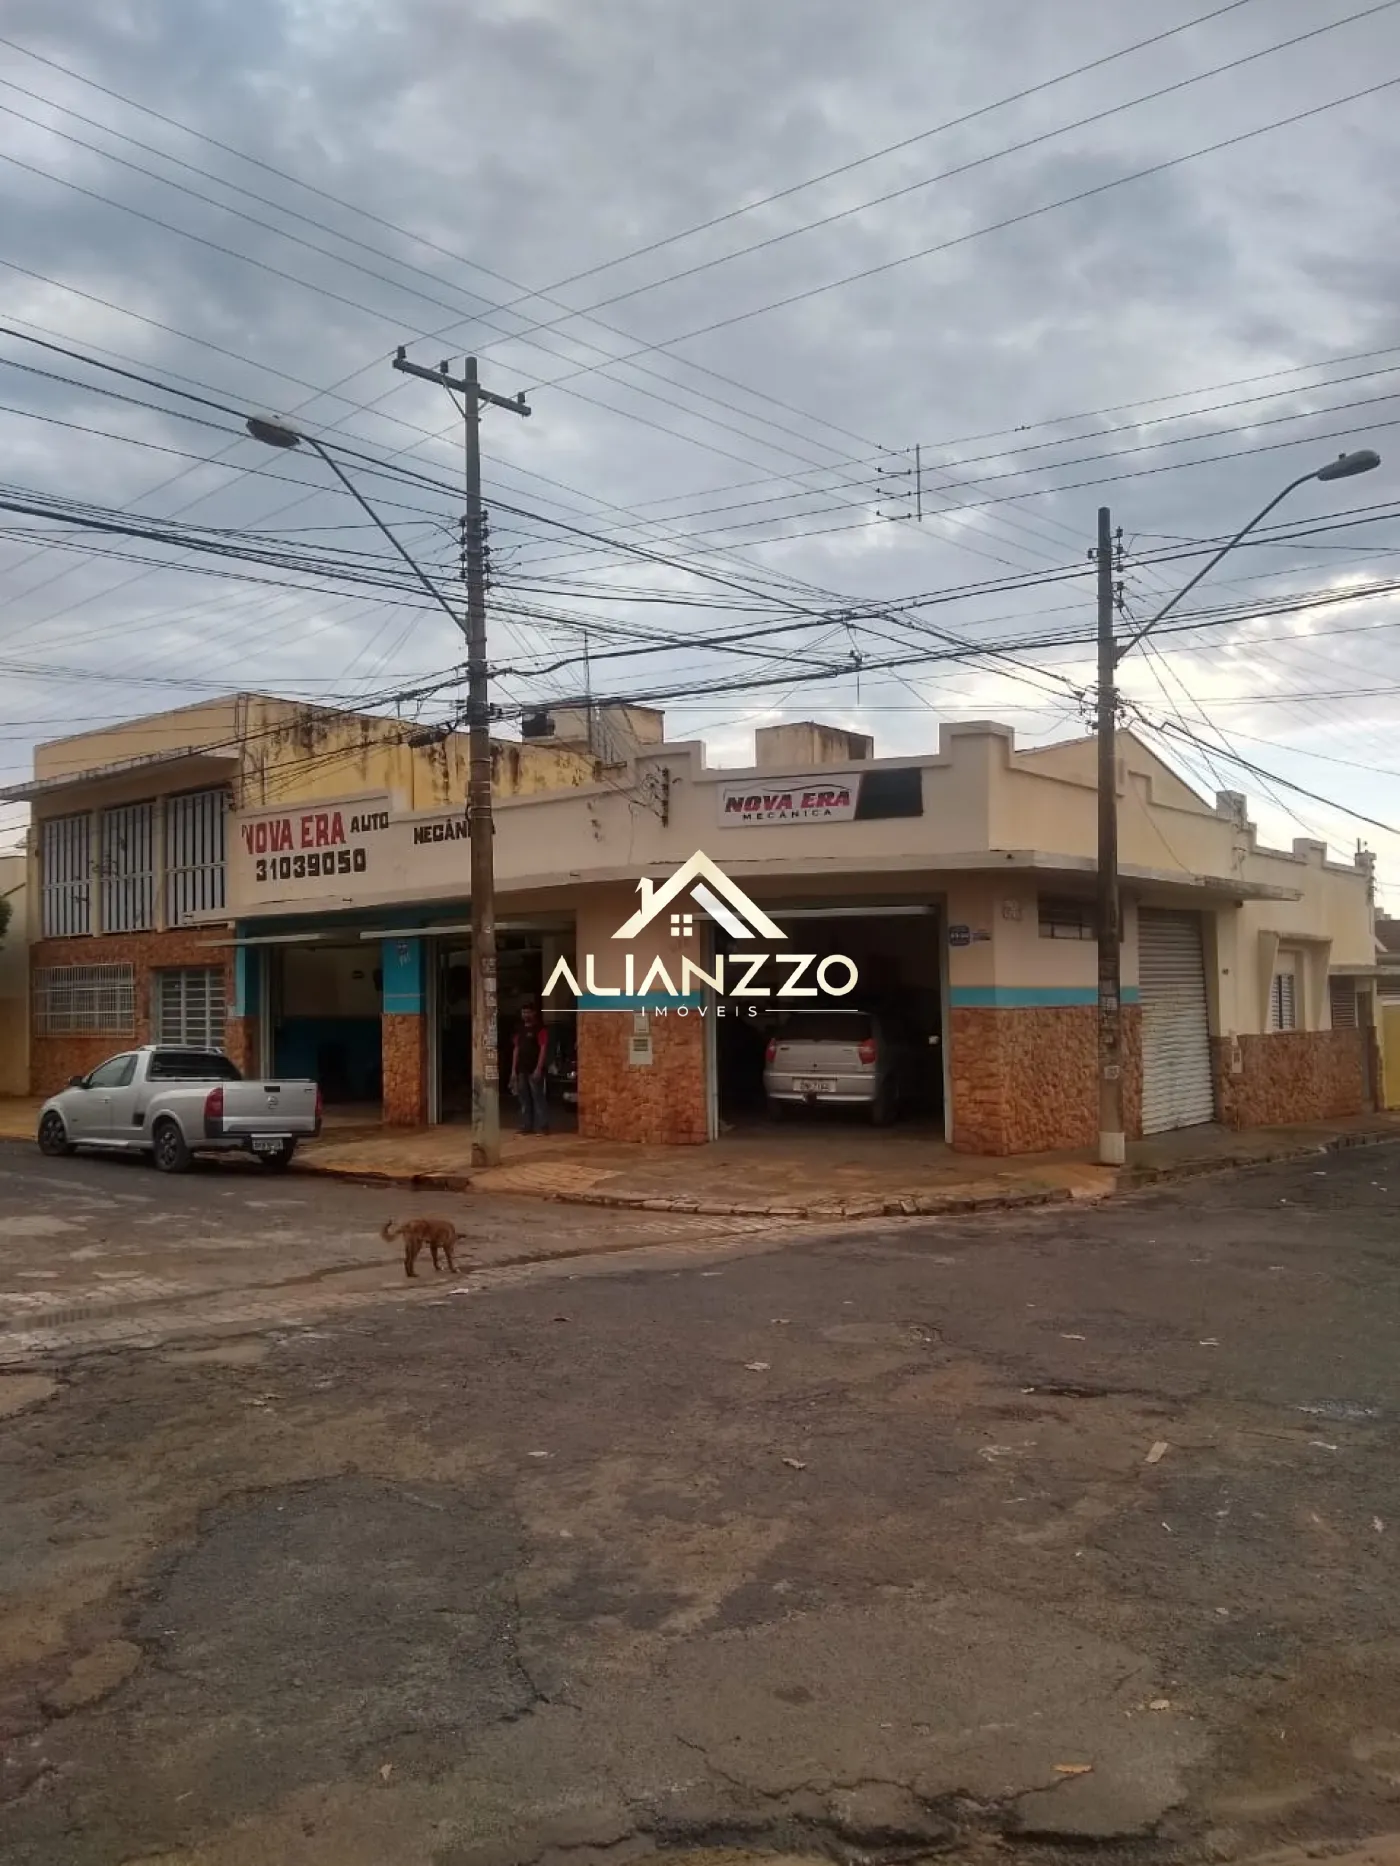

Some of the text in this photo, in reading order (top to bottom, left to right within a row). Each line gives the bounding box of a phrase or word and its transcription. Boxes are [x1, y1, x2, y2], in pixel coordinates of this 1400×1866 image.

[724, 790, 851, 813] NOVA ERA
[743, 808, 832, 821] MECÂNICA
[241, 818, 294, 855] NOVA
[300, 811, 347, 849] ERA
[350, 811, 389, 833] AUTO
[256, 848, 367, 882] 31039050
